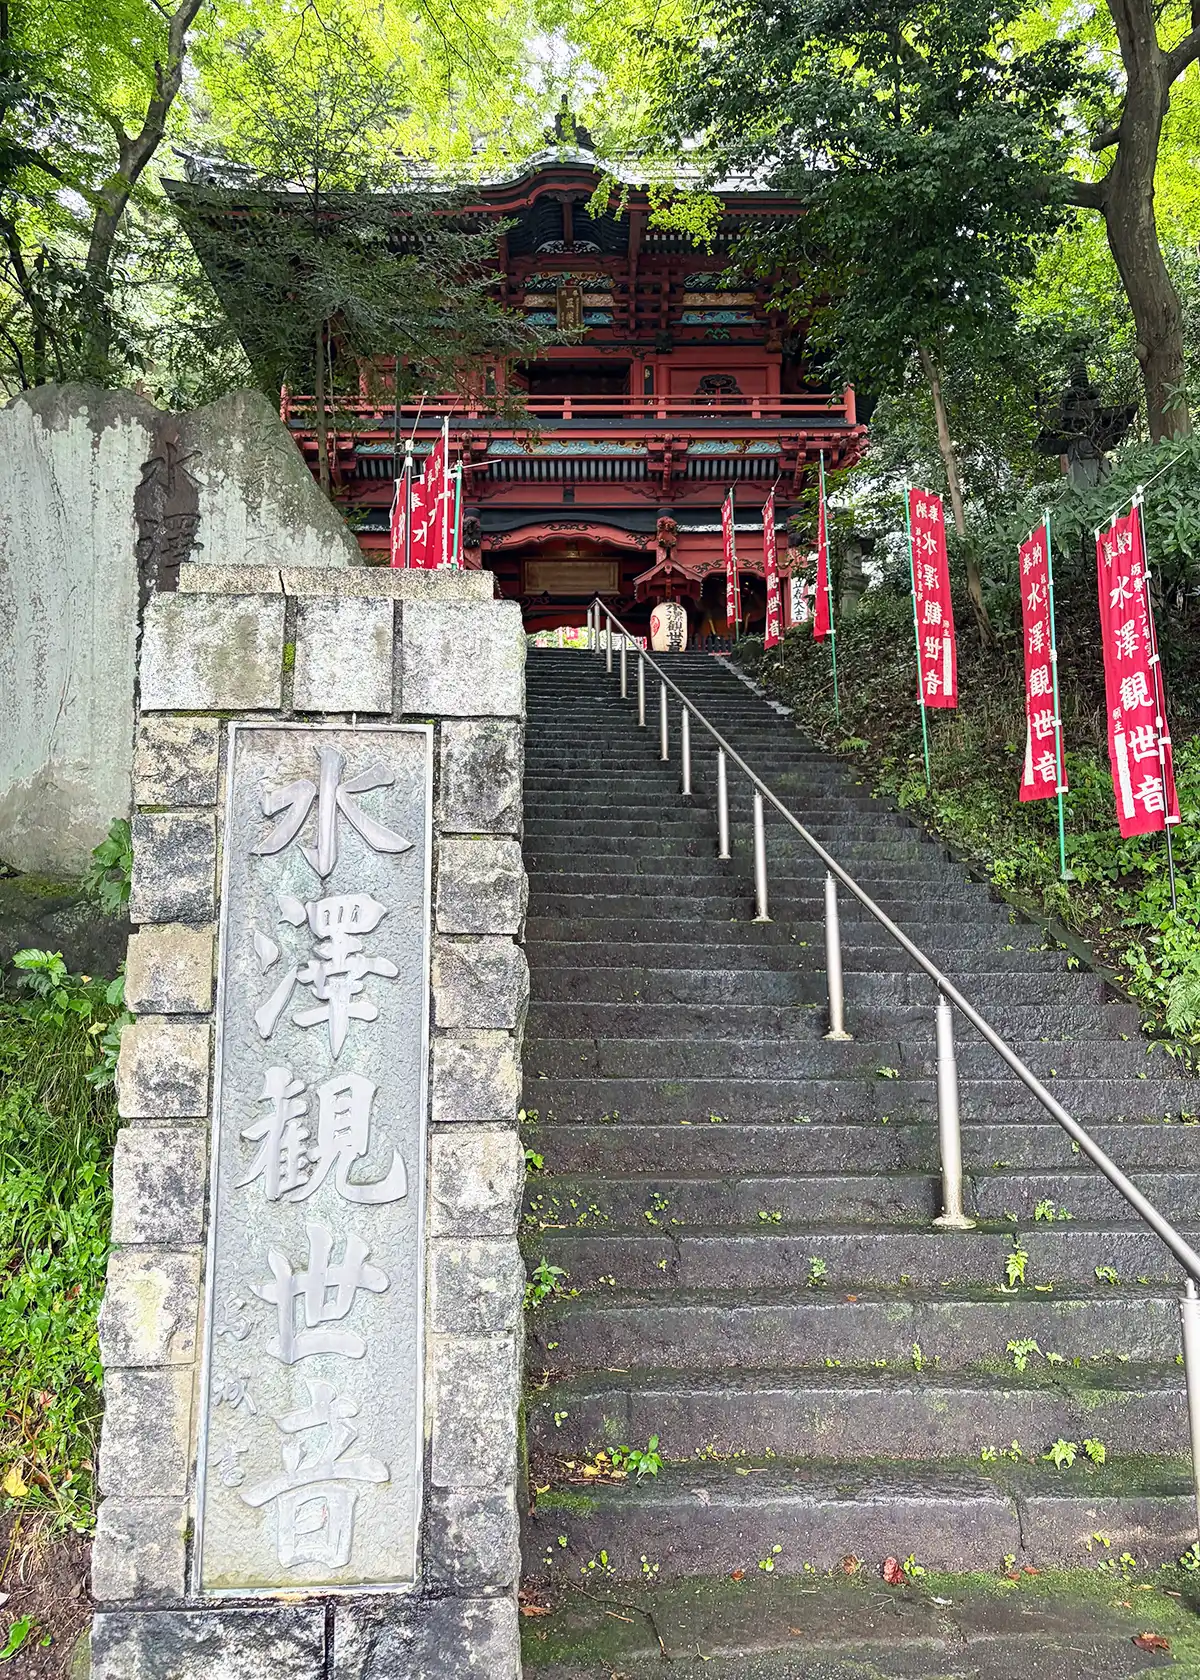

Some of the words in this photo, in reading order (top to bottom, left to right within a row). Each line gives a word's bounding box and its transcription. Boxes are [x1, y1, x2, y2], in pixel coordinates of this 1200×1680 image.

[1023, 543, 1042, 575] 奉納
[1102, 531, 1133, 568] 奉納
[1131, 562, 1153, 669] 坂東十六番霊
[1027, 583, 1057, 783] 水澤観世音
[1109, 576, 1165, 814] 水澤観世音
[1112, 707, 1124, 734] 願主
[235, 744, 415, 1570] 水澤観世音
